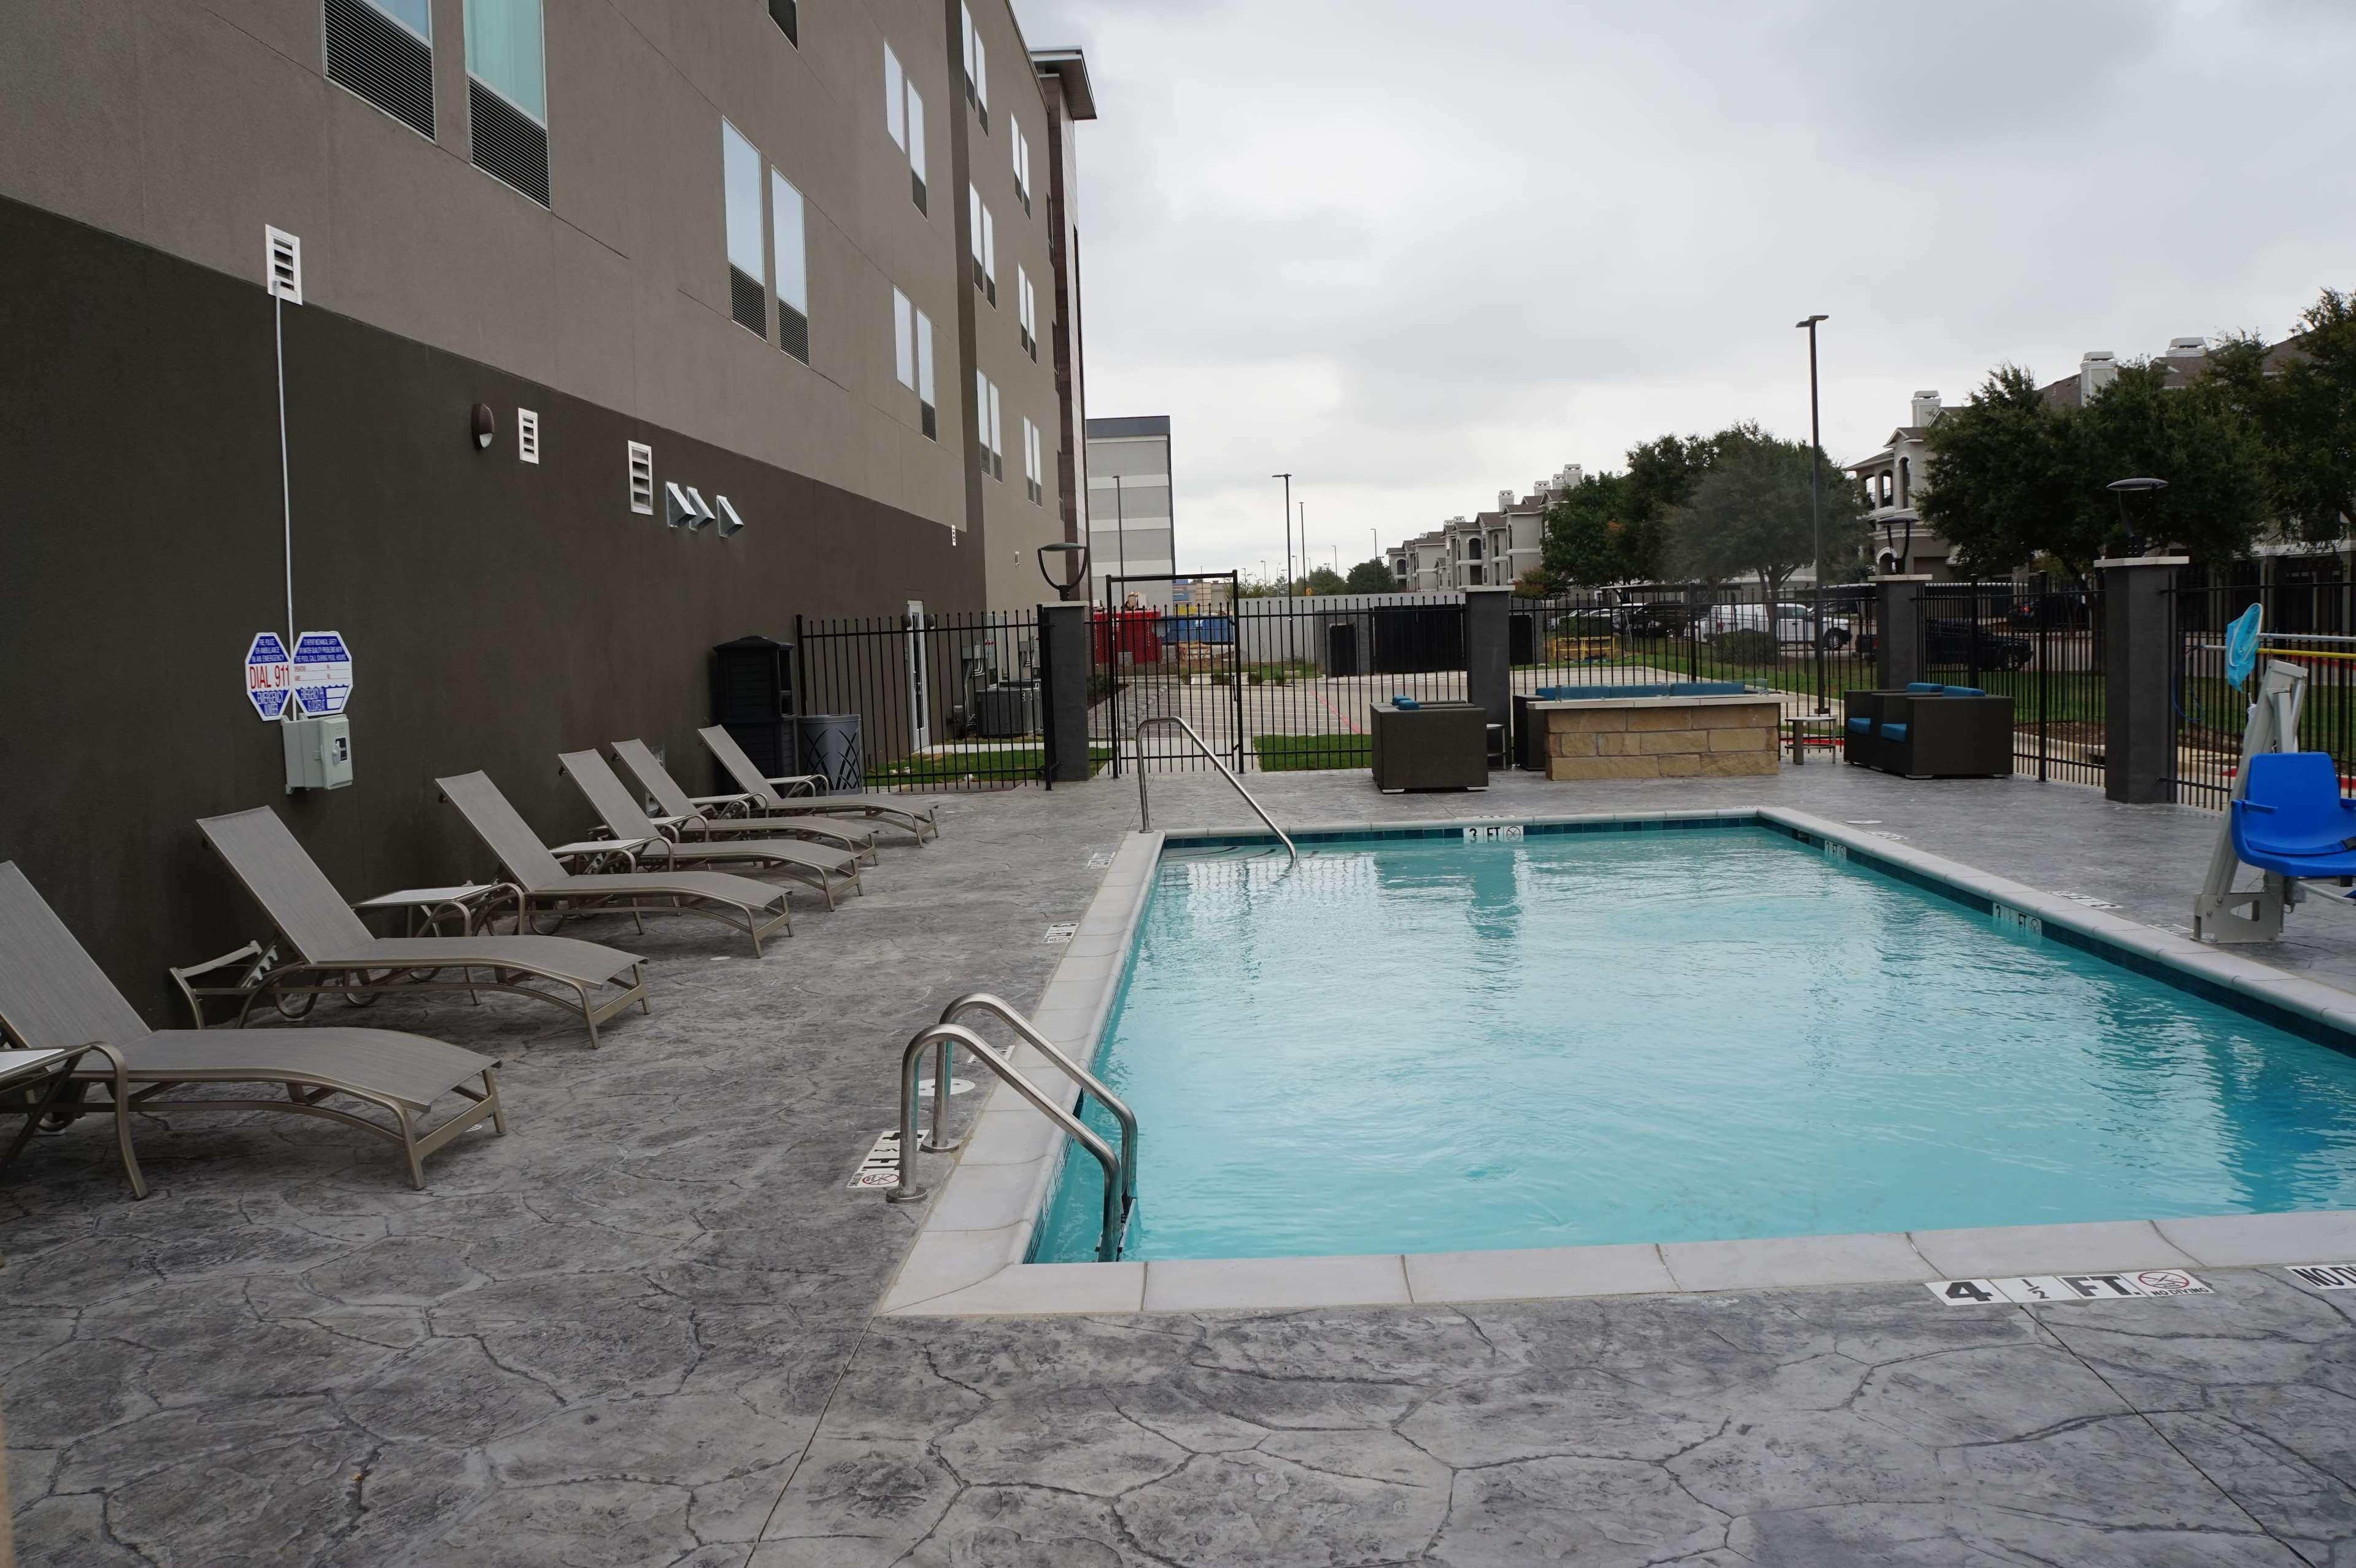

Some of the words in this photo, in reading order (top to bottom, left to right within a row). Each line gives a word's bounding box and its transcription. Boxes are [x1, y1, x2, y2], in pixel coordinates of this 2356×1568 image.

[250, 666, 271, 689] DIAL
[275, 665, 290, 687] 911
[257, 691, 284, 705] EMERGENCY
[2292, 1269, 2344, 1286] NO
[1945, 1281, 1993, 1302] 4
